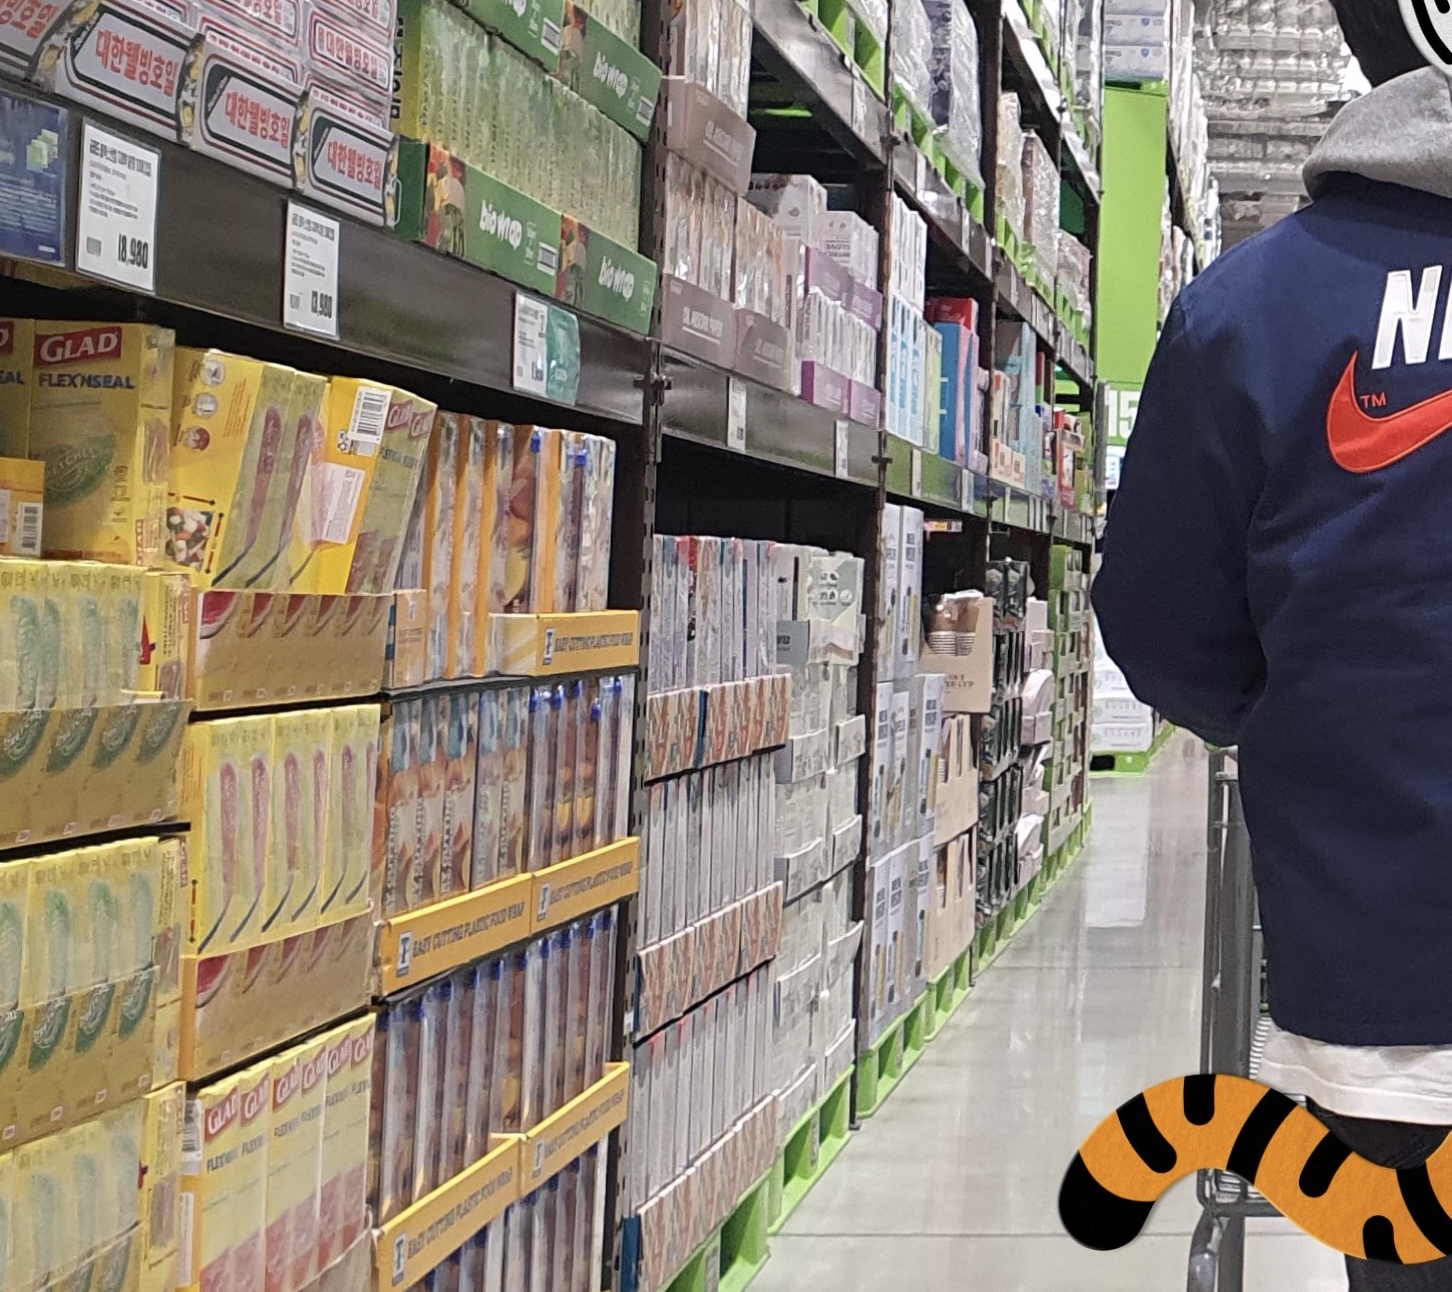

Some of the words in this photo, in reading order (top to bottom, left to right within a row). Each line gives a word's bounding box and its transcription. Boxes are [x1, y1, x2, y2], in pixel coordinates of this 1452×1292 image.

[95, 28, 178, 98] 대한웰빙호일
[225, 90, 290, 150] 대한웰빙호일
[327, 140, 382, 191] 대한웰빙호일
[118, 233, 149, 269] 18,980
[40, 330, 119, 364] GLAD
[1107, 390, 1140, 438] 15
[1360, 392, 1387, 409] TM
